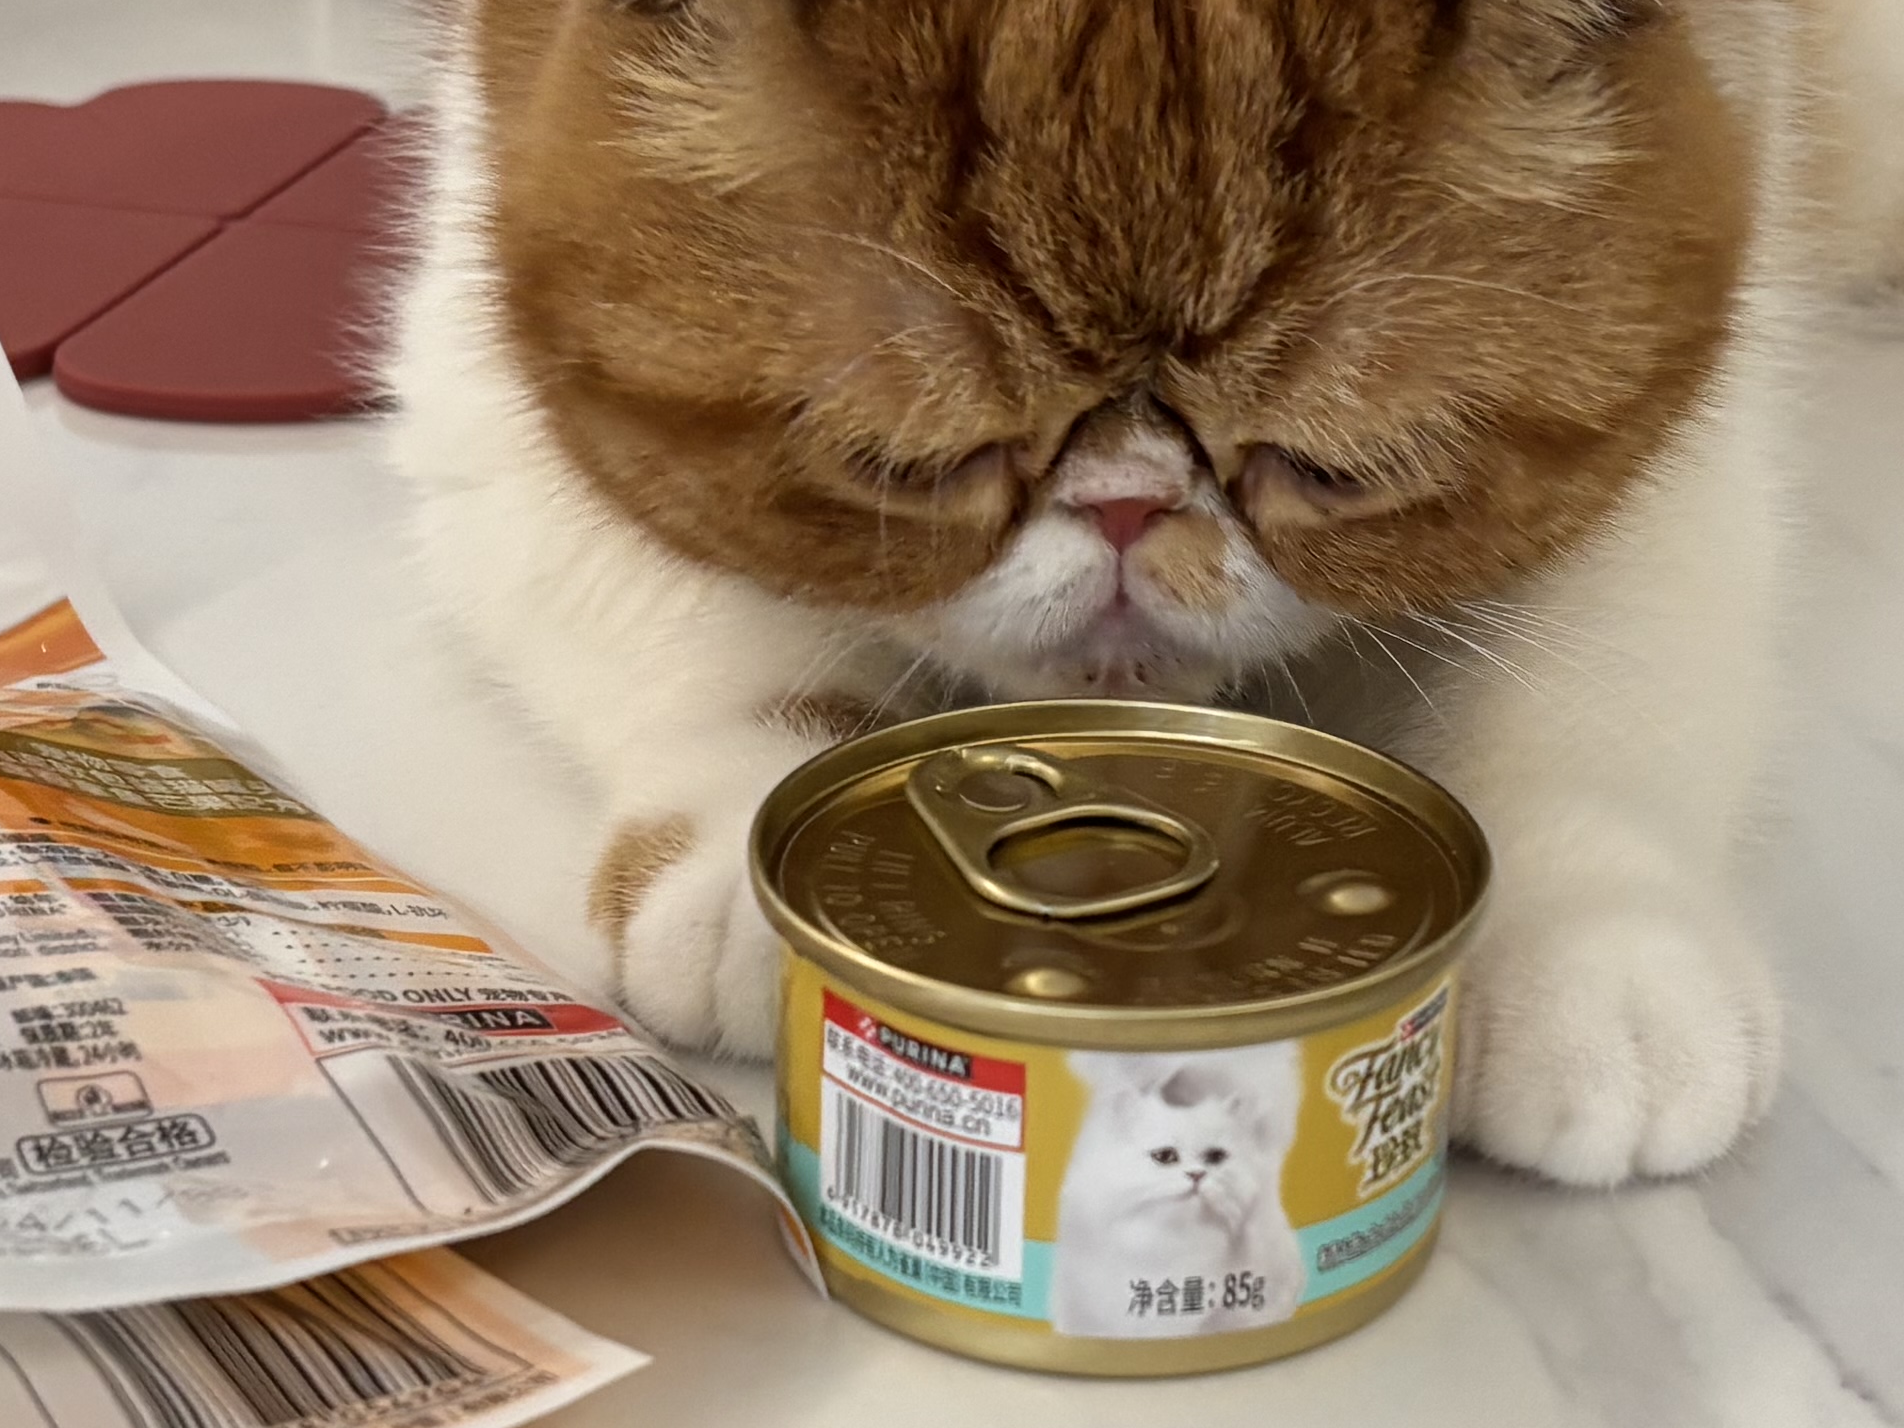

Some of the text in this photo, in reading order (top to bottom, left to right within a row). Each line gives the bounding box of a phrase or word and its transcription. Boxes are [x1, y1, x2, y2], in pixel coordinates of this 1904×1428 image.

[402, 987, 473, 1005] ONLY
[879, 1025, 965, 1079] PURINA
[29, 1119, 200, 1168] 检验合格
